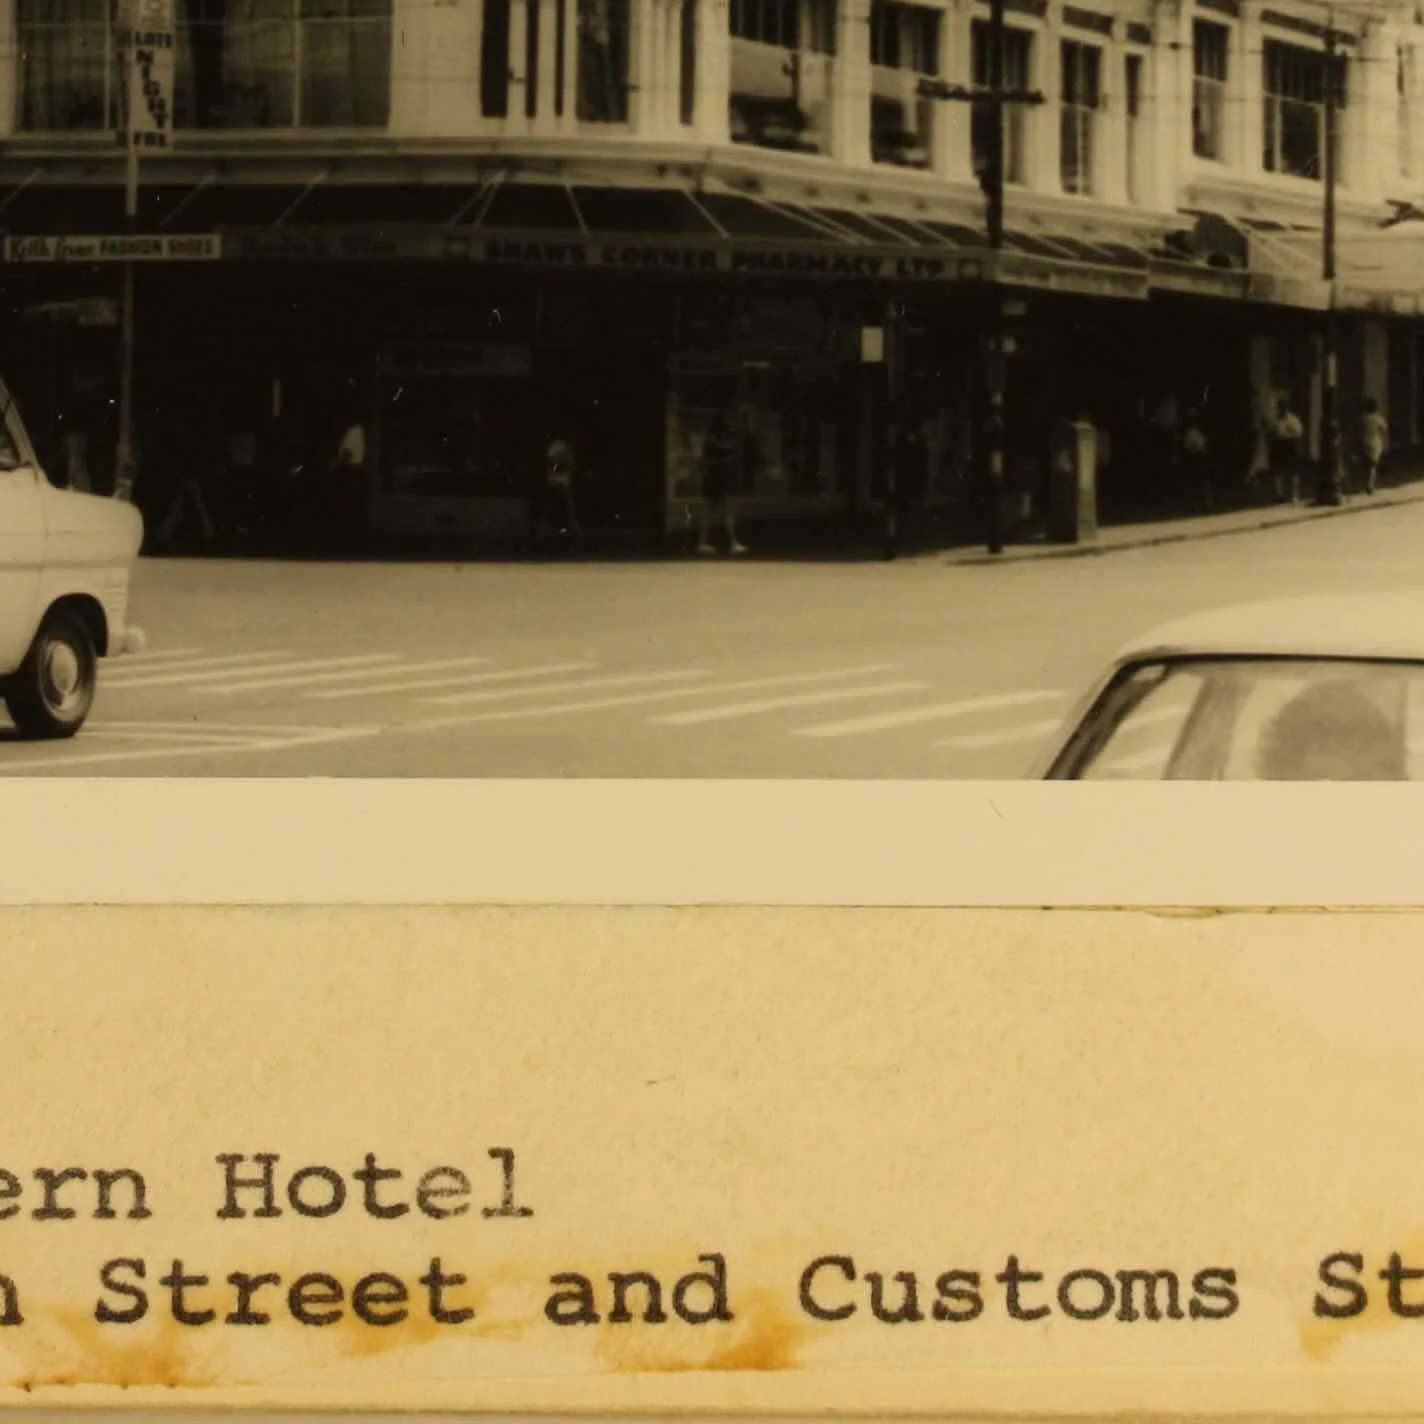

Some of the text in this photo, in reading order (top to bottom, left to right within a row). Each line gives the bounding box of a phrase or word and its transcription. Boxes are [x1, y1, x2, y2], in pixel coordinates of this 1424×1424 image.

[216, 1147, 535, 1220] Hotel
[94, 1257, 475, 1328] Street
[544, 1253, 735, 1326] and
[799, 1255, 1239, 1325] Customs
